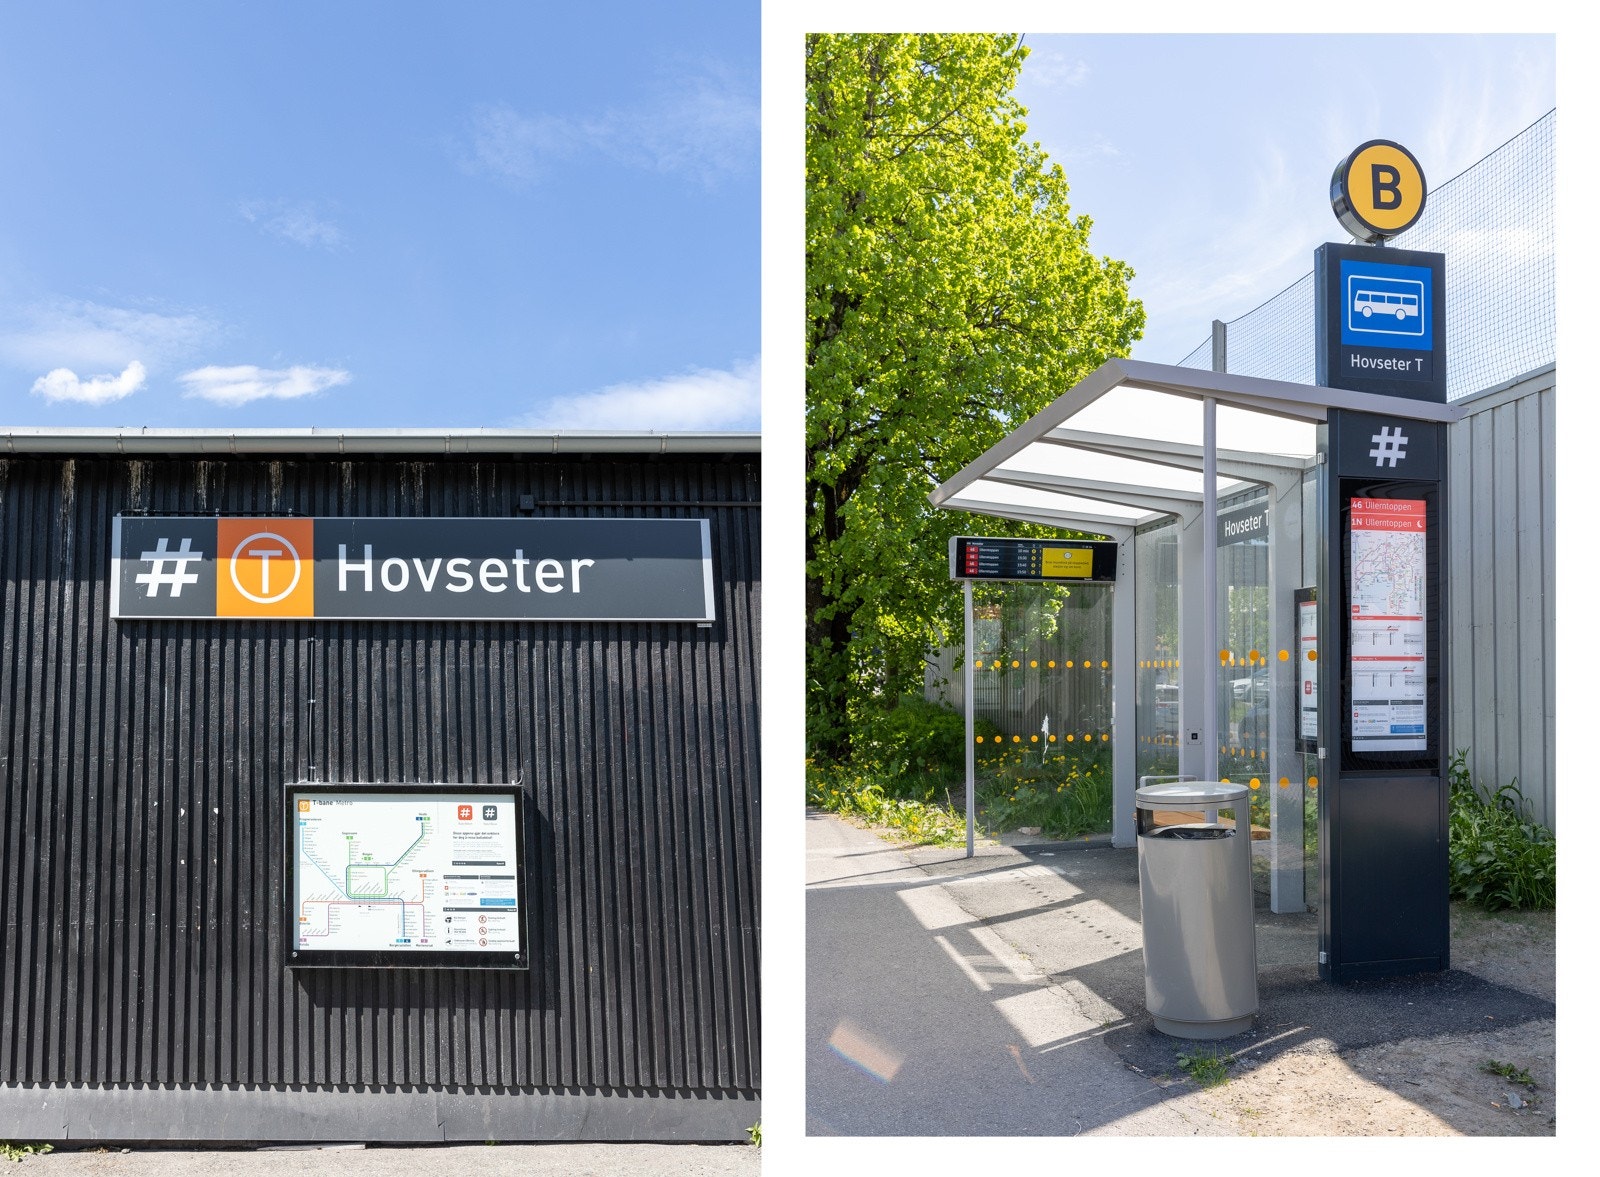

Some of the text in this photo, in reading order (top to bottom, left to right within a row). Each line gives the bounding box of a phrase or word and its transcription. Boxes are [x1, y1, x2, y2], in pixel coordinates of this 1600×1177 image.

[1371, 164, 1402, 210] B
[1351, 354, 1423, 371] Hovseter T
[1352, 501, 1412, 512] 46 Ullerntoppen
[1224, 515, 1262, 537] Hovseter
[1351, 518, 1412, 528] 1N Ullerntoppen
[249, 550, 283, 594] T
[338, 544, 595, 594] Hovseter
